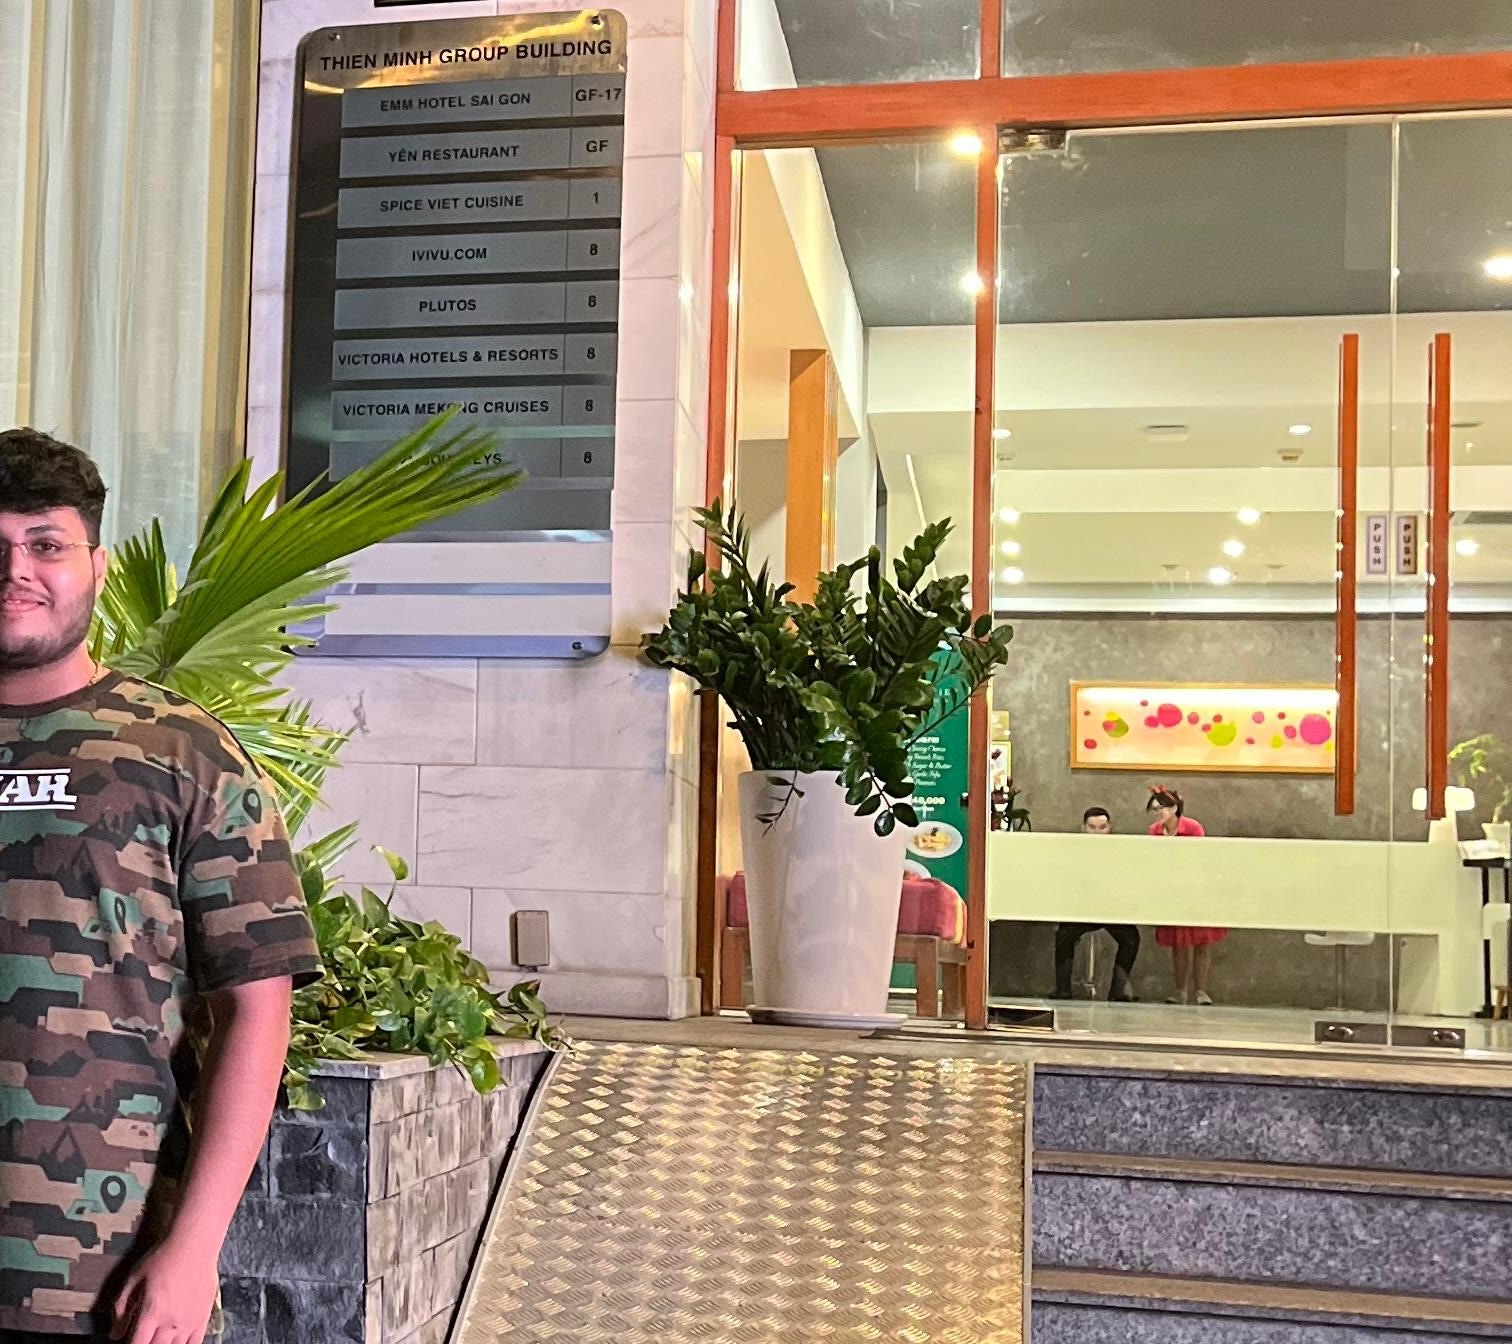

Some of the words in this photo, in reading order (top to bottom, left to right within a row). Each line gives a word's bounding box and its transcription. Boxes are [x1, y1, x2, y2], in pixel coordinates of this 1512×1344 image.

[320, 53, 377, 72] THIEN
[383, 49, 433, 68] MINH
[438, 46, 509, 65] GROUP
[515, 39, 613, 60] BUILDING
[575, 87, 623, 103] GF-17
[380, 98, 413, 112] EMM
[418, 95, 464, 109] HOTEL
[585, 139, 609, 153] GF
[388, 147, 418, 163] YÊN
[422, 145, 520, 162] RESTAURANT
[379, 199, 423, 212] SPICE
[426, 197, 460, 211] VIET
[464, 195, 524, 209] CUISINE
[592, 192, 600, 204] 1
[411, 247, 488, 262] IVIVU.COM
[589, 243, 599, 256] 8
[419, 299, 477, 313] PLUTOS
[587, 294, 597, 308] 8
[337, 352, 405, 366] VICTORIA
[410, 350, 468, 364] HOTELS
[472, 350, 483, 362] &
[487, 348, 559, 362] RESORTS
[586, 346, 596, 360] 8
[343, 402, 411, 416] VICTORIA
[483, 400, 550, 414] CRUISES
[584, 398, 594, 412] 8
[583, 451, 593, 464] 8
[1372, 522, 1382, 566] PUSH
[1402, 522, 1412, 567] PUSH
